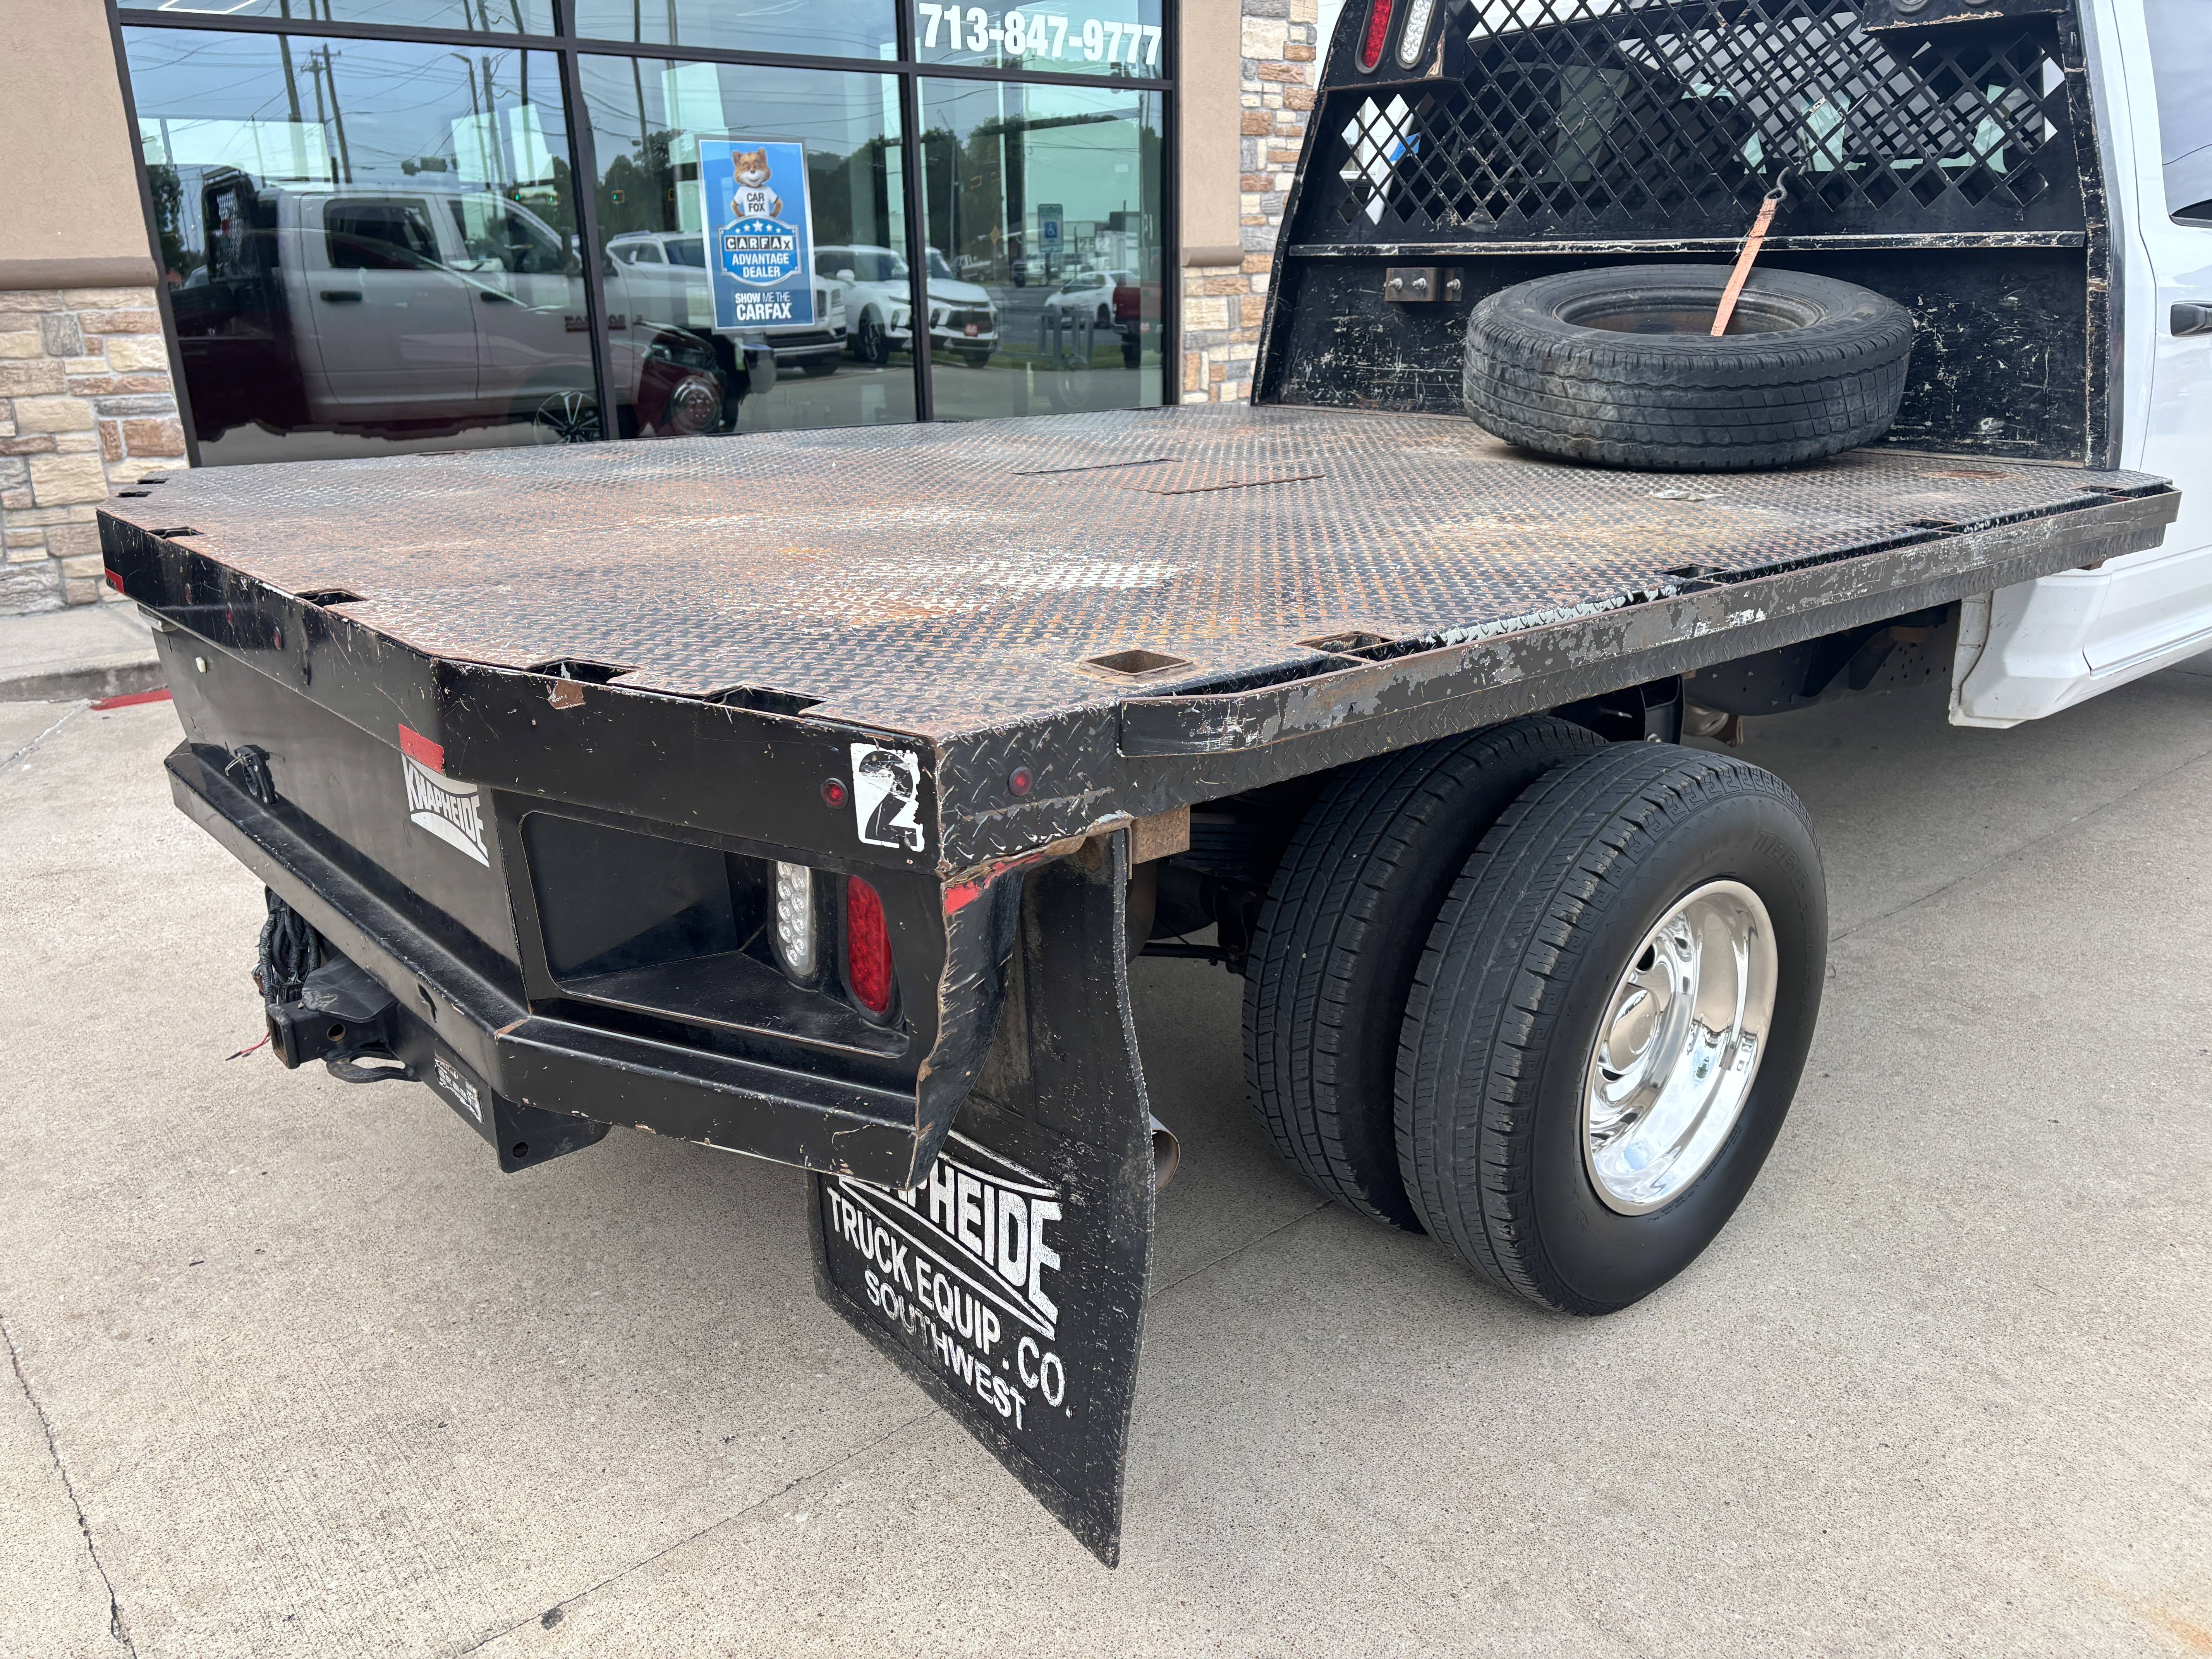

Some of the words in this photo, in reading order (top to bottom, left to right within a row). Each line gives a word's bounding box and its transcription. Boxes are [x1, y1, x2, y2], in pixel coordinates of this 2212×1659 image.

[919, 3, 1162, 65] 713-847-9777
[747, 192, 764, 202] CAR
[749, 203, 766, 212] FOX
[726, 237, 792, 250] CARFAX
[732, 252, 790, 266] ADVANTAGE
[743, 266, 781, 278] DEALER
[735, 292, 761, 304] SHOW
[762, 292, 775, 303] ME
[775, 291, 791, 302] THE
[736, 302, 792, 321] CARFAX
[401, 752, 488, 859] KNAPHEIDE
[827, 1185, 912, 1293] TRUCK
[1018, 1336, 1073, 1419] CO.
[865, 1269, 1027, 1431] SOUTHWEST
